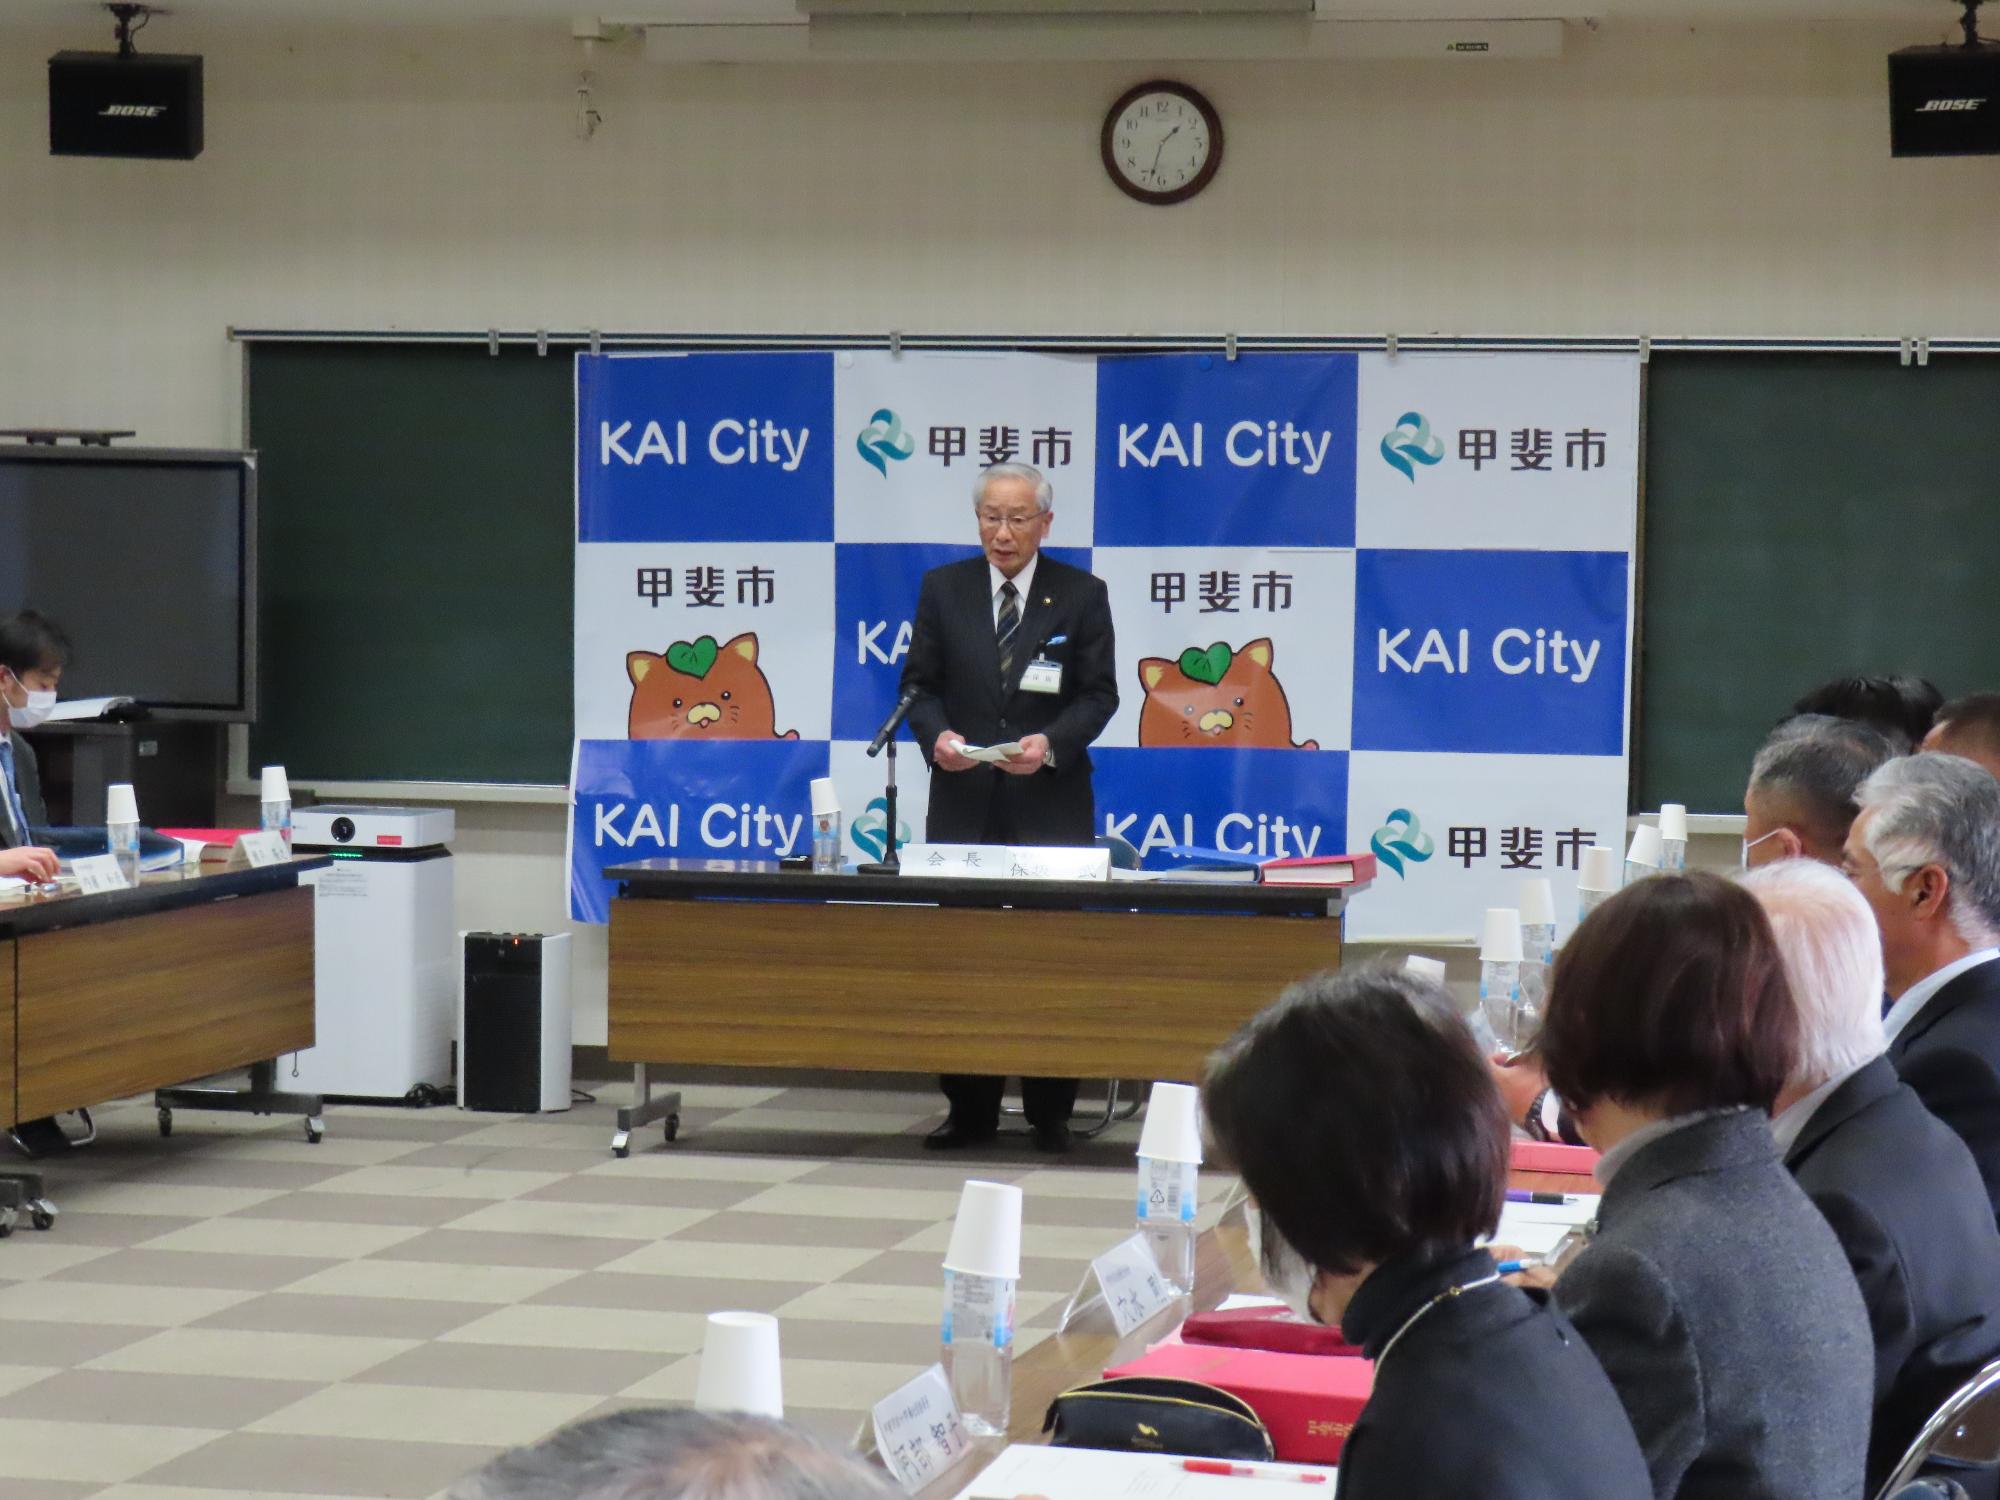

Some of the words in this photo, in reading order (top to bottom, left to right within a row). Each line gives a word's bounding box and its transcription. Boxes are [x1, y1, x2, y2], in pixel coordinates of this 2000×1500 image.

[98, 105, 167, 116] BOSE
[1126, 120, 1138, 130] 10
[1140, 106, 1148, 117] 11
[1157, 101, 1169, 113] 12
[1915, 98, 1987, 112] BOSE
[601, 420, 687, 465] KAI
[708, 418, 810, 471] City
[929, 426, 1072, 468] 甲斐市
[1118, 422, 1203, 468] KAI
[1225, 420, 1332, 475] City
[1458, 428, 1607, 471] 甲斐市
[637, 566, 775, 608] 甲斐市
[1150, 571, 1292, 613] 甲斐市
[858, 620, 913, 665] KA
[1378, 628, 1469, 674] KAI
[1492, 627, 1601, 684] City
[594, 803, 679, 848] KAI
[700, 802, 803, 857] City
[1106, 813, 1193, 858] KAI
[1448, 826, 1597, 870] 甲斐市
[928, 851, 982, 868] 会長
